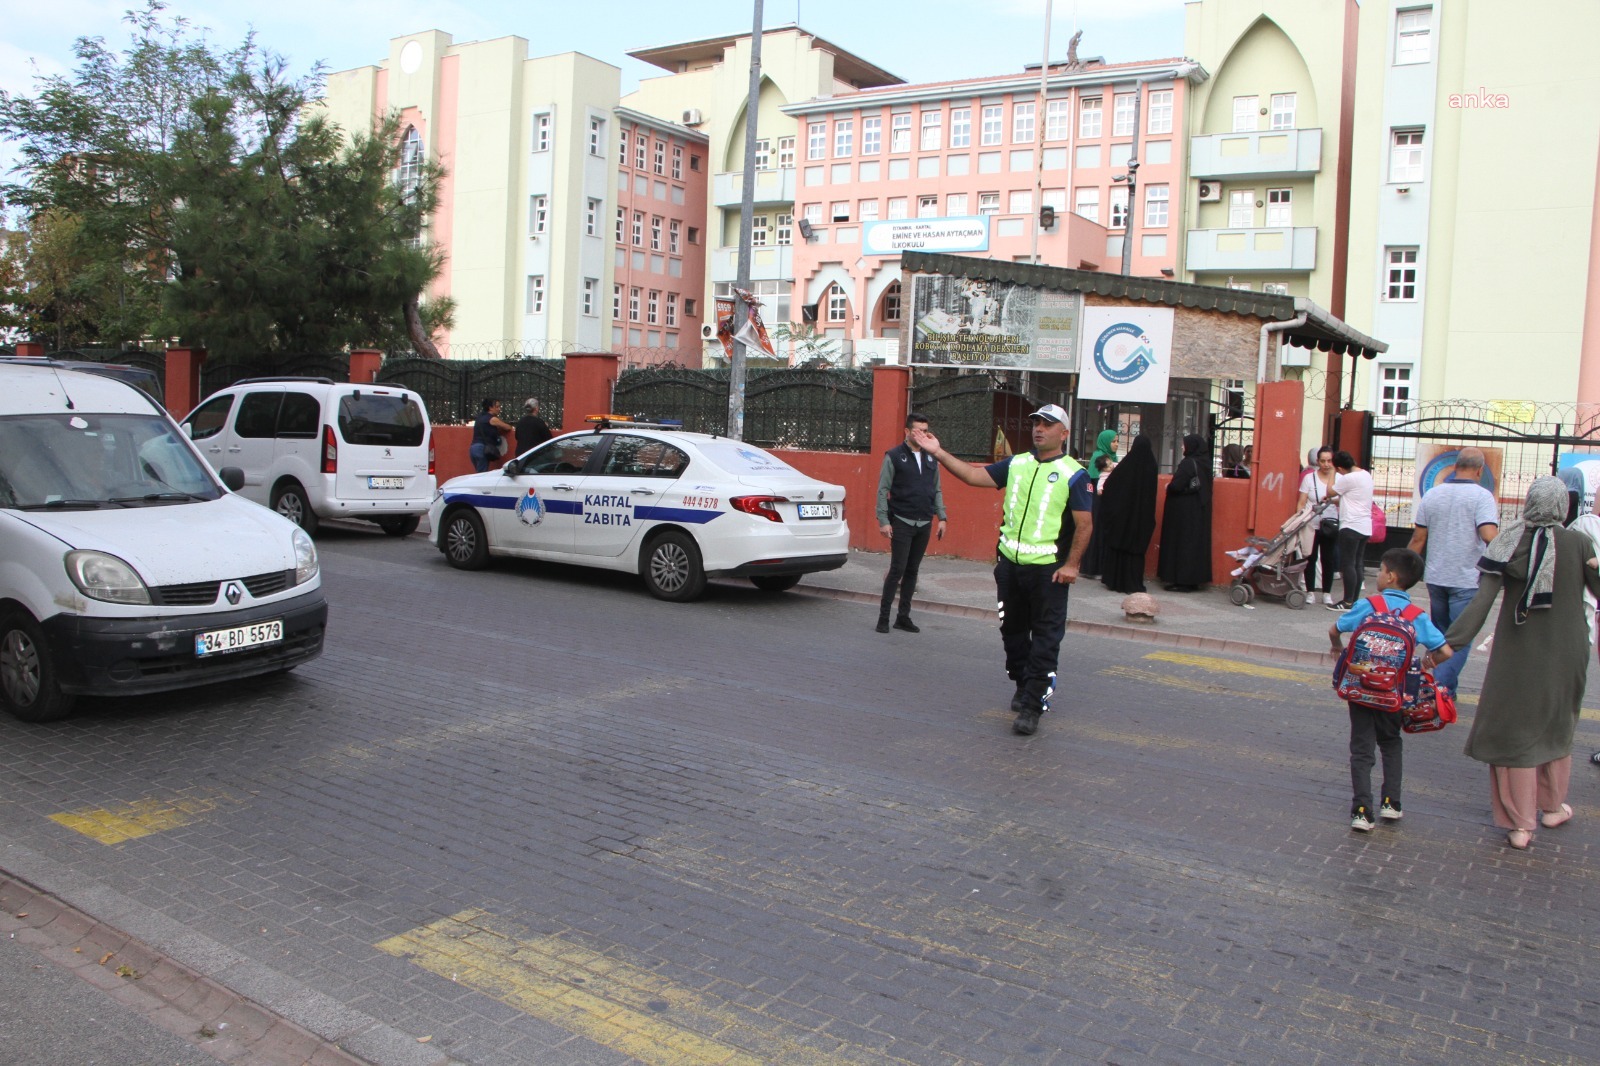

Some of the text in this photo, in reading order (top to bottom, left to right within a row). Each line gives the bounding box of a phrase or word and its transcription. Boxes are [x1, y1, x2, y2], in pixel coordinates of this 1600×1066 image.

[892, 232, 912, 240] EMİNE
[922, 230, 945, 238] HASAN
[946, 230, 982, 238] AYTAÇMAN
[950, 344, 988, 352] KODLAMA
[990, 344, 1030, 354] DERSLERİ
[950, 353, 990, 362] BAŞLIYOR
[584, 494, 632, 508] KARTAL
[682, 496, 719, 509] 444 4 578
[802, 506, 808, 515] 34
[1032, 483, 1054, 538] ZABITA
[584, 512, 631, 526] ZABITA
[206, 633, 222, 650] 34
[229, 630, 244, 646] BD
[250, 623, 280, 642] 5573
